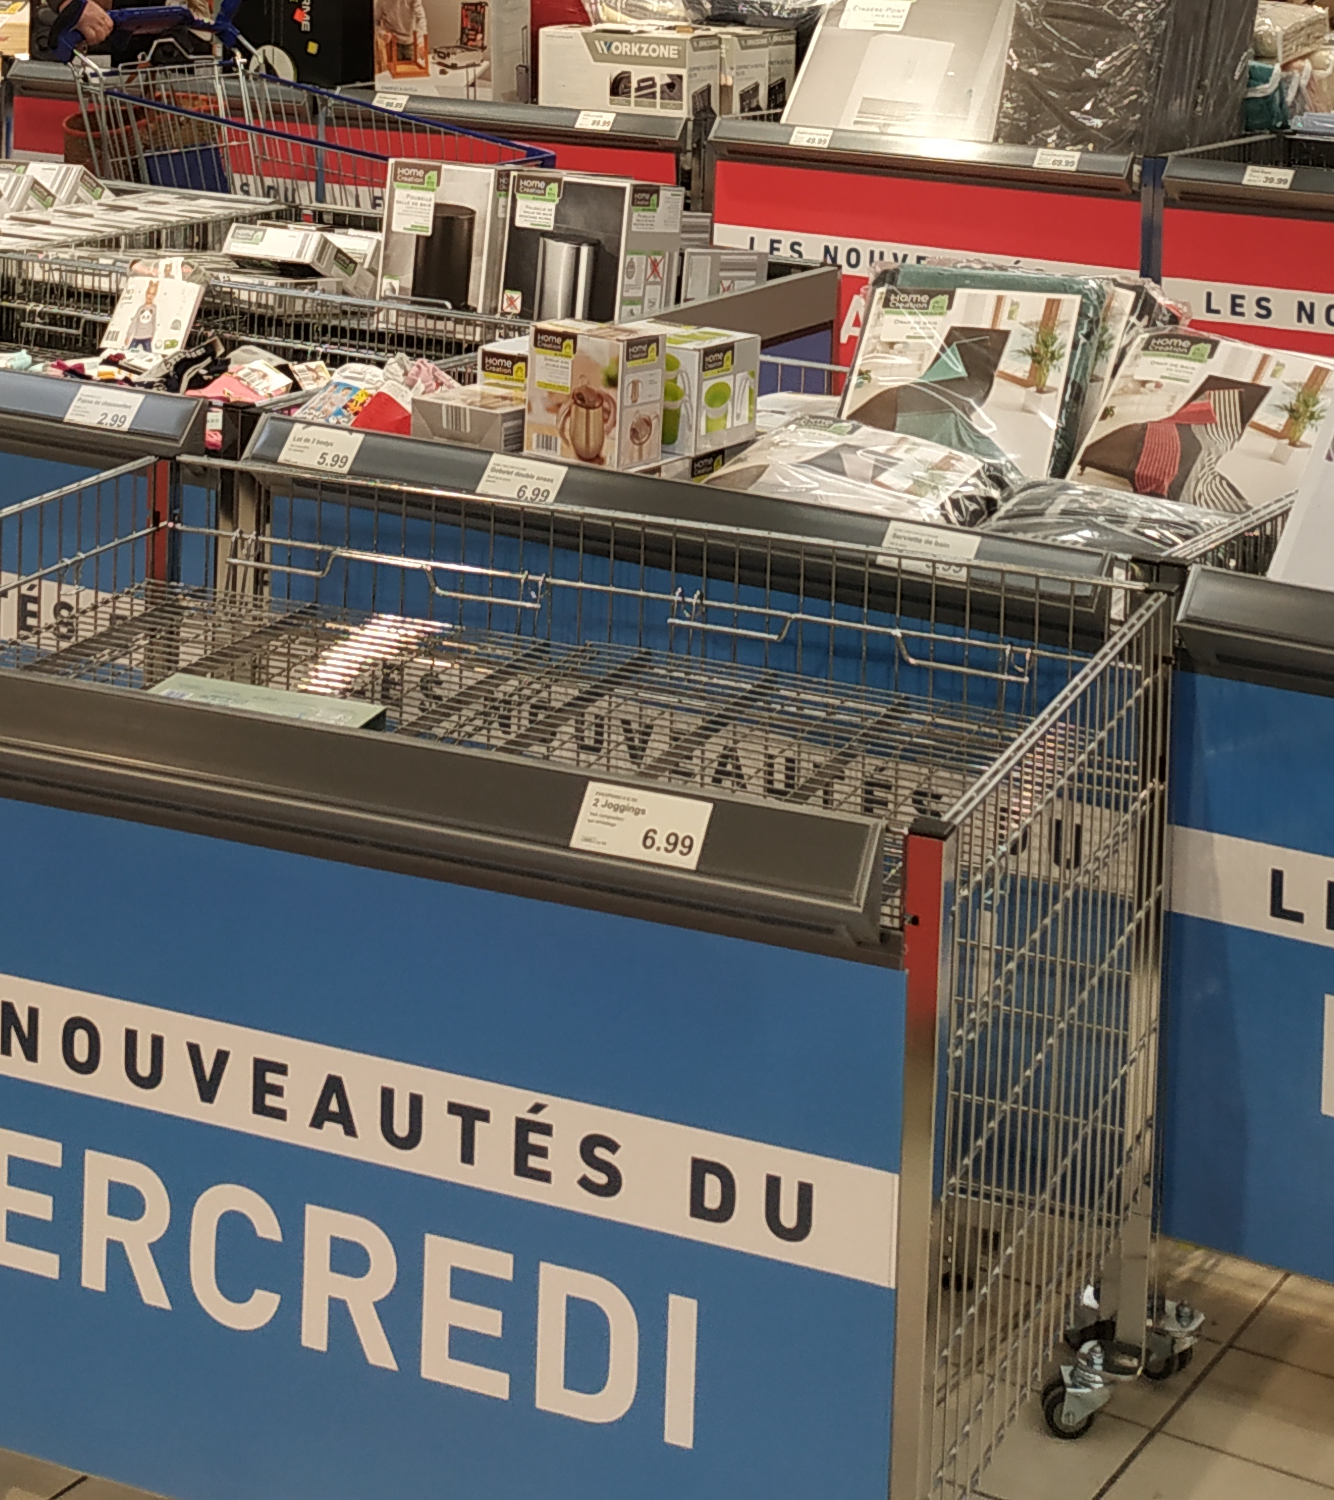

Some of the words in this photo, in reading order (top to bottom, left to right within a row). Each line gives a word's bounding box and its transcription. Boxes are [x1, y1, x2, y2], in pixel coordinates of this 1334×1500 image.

[594, 39, 680, 59] WORKZONE
[1205, 290, 1274, 320] LES
[537, 332, 562, 345] Home
[1152, 338, 1191, 348] Home
[485, 356, 512, 369] Home
[96, 412, 127, 428] 2.99
[316, 451, 349, 469] 5.99
[516, 484, 551, 503] 6.99
[592, 797, 600, 808] 2
[600, 799, 647, 817] Joggings
[642, 828, 694, 857] 6.99
[688, 1155, 816, 1245] DU
